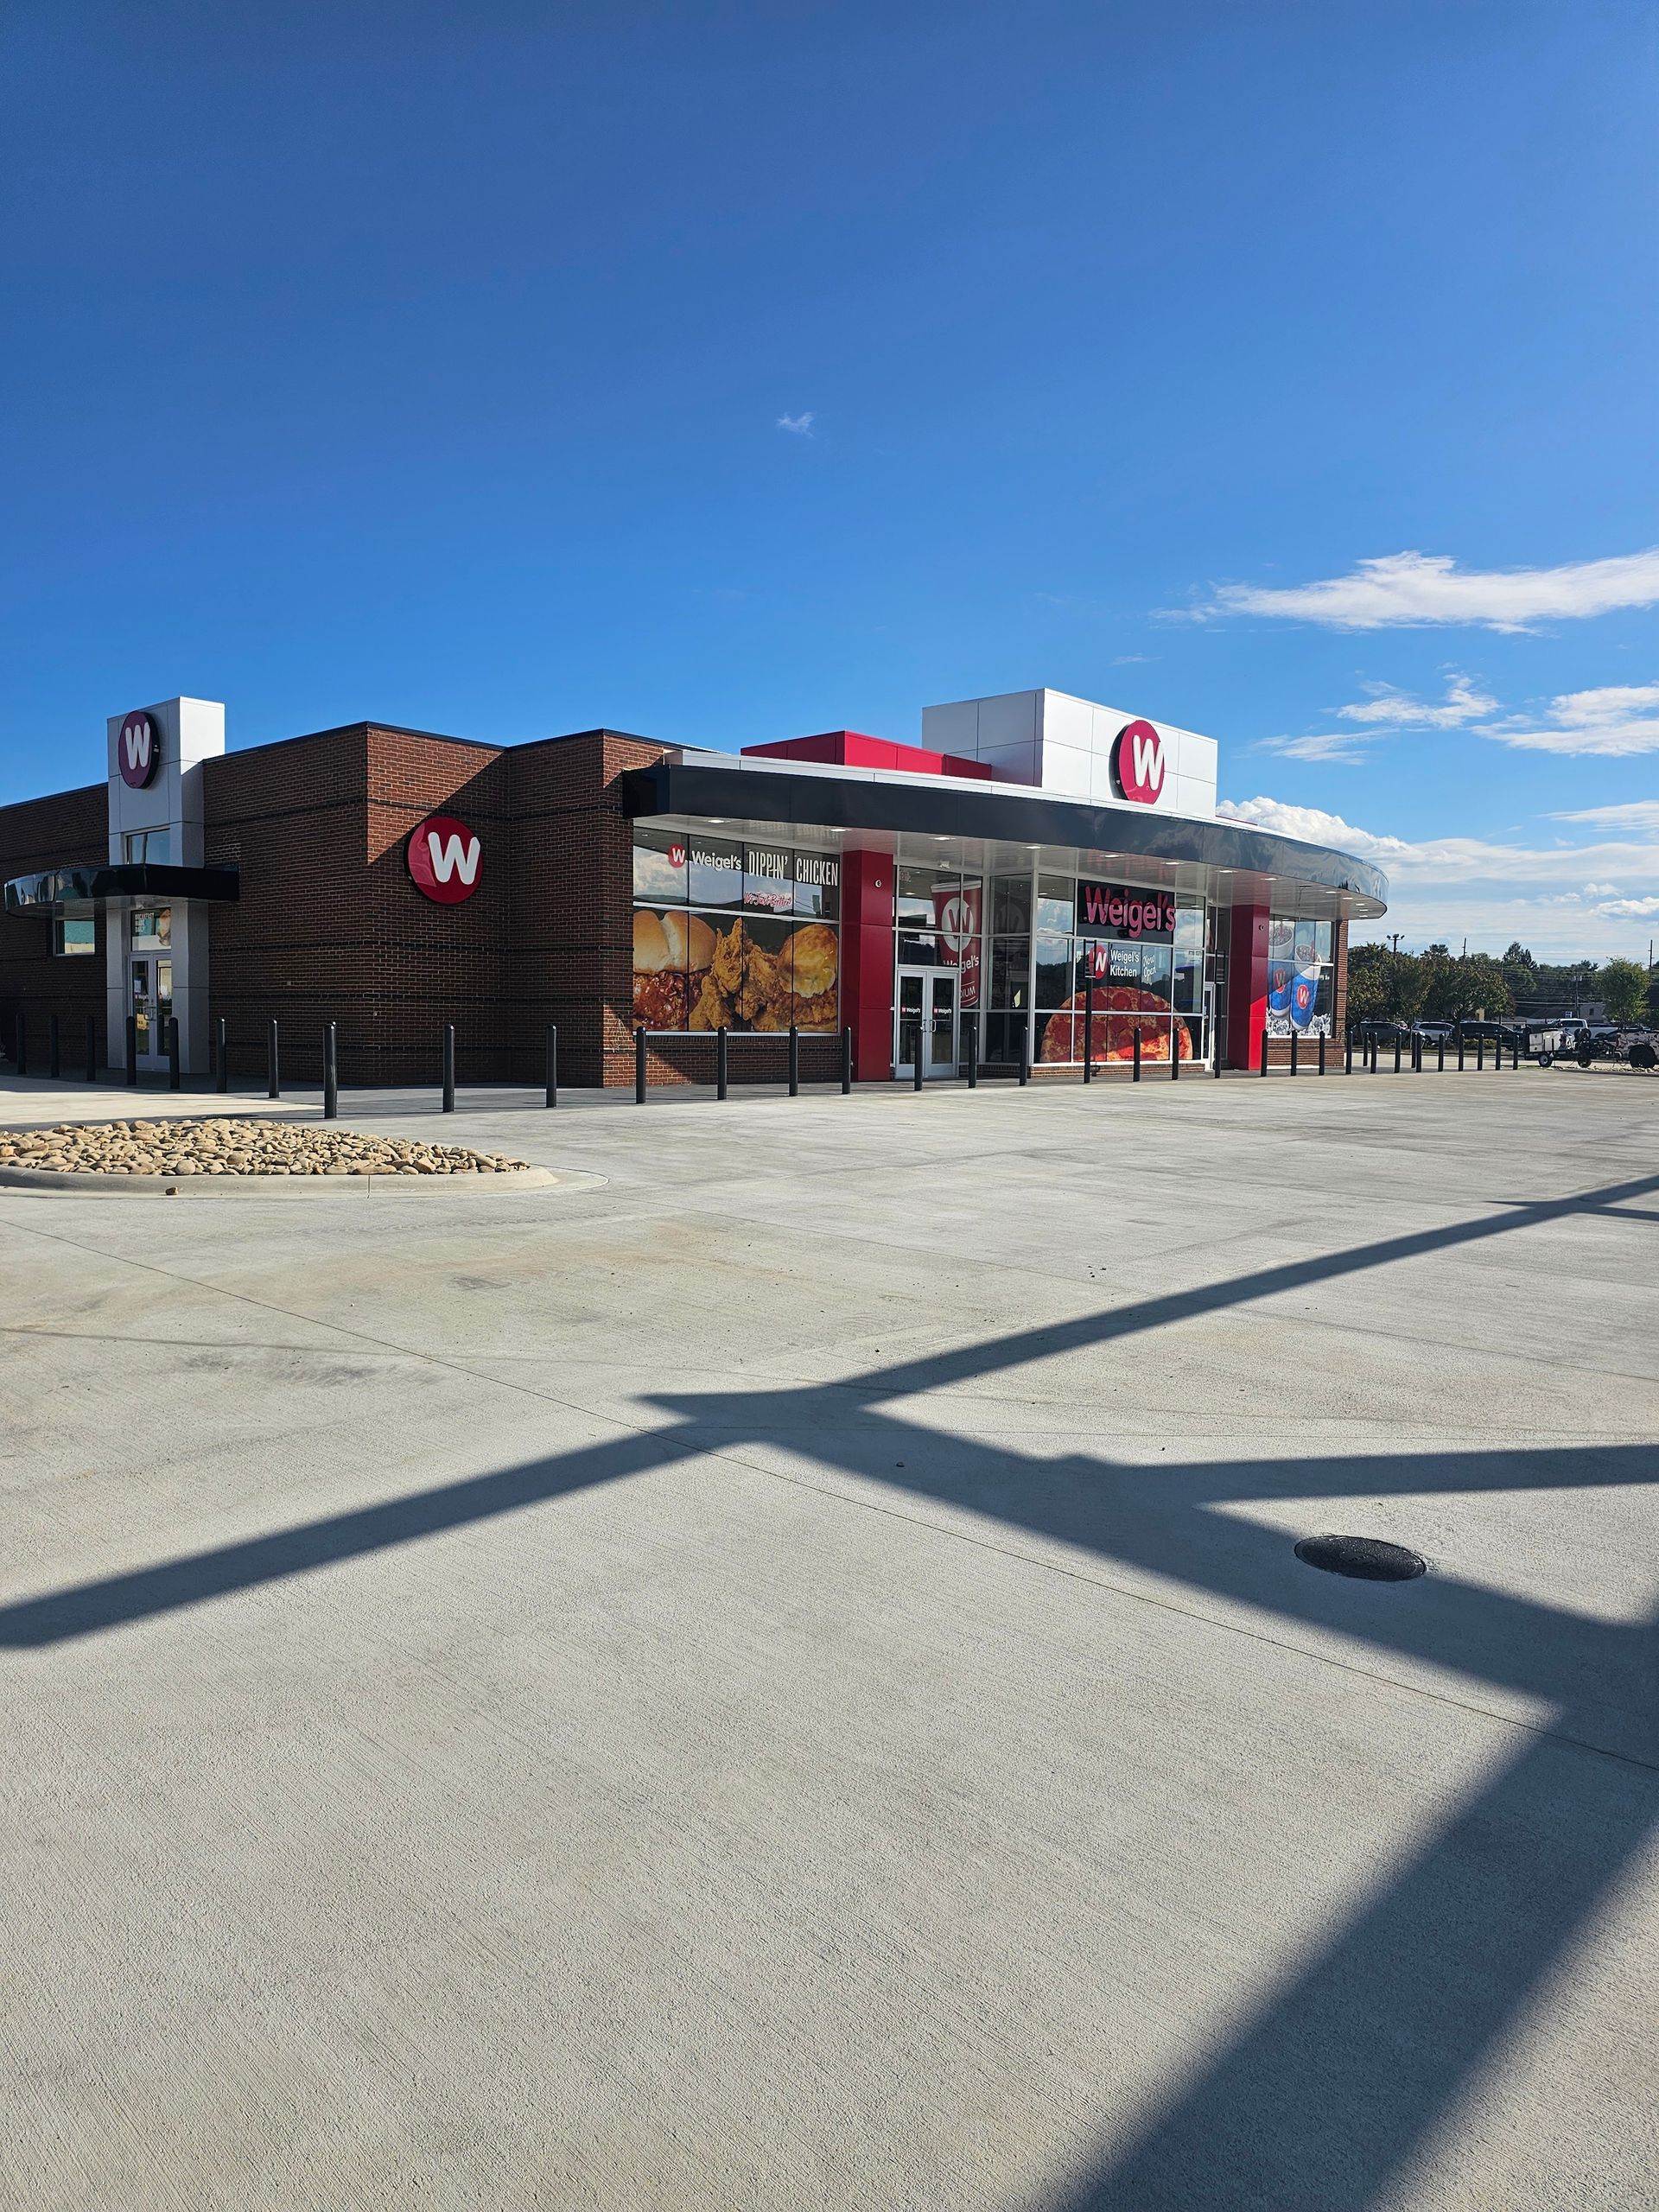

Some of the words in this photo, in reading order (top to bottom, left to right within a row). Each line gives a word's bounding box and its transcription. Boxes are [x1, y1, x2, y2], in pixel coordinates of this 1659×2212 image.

[125, 722, 150, 770] W
[1133, 734, 1165, 791] W
[428, 831, 481, 885] W
[672, 848, 685, 863] W
[691, 850, 742, 872] Weigel's
[748, 851, 788, 880] DIPPIN'
[796, 858, 838, 887] CHICKEN
[1085, 886, 1176, 938] Weigel's
[1110, 950, 1140, 963] Weigel's
[1110, 964, 1137, 977] Kitchen
[1300, 988, 1310, 1007] W
